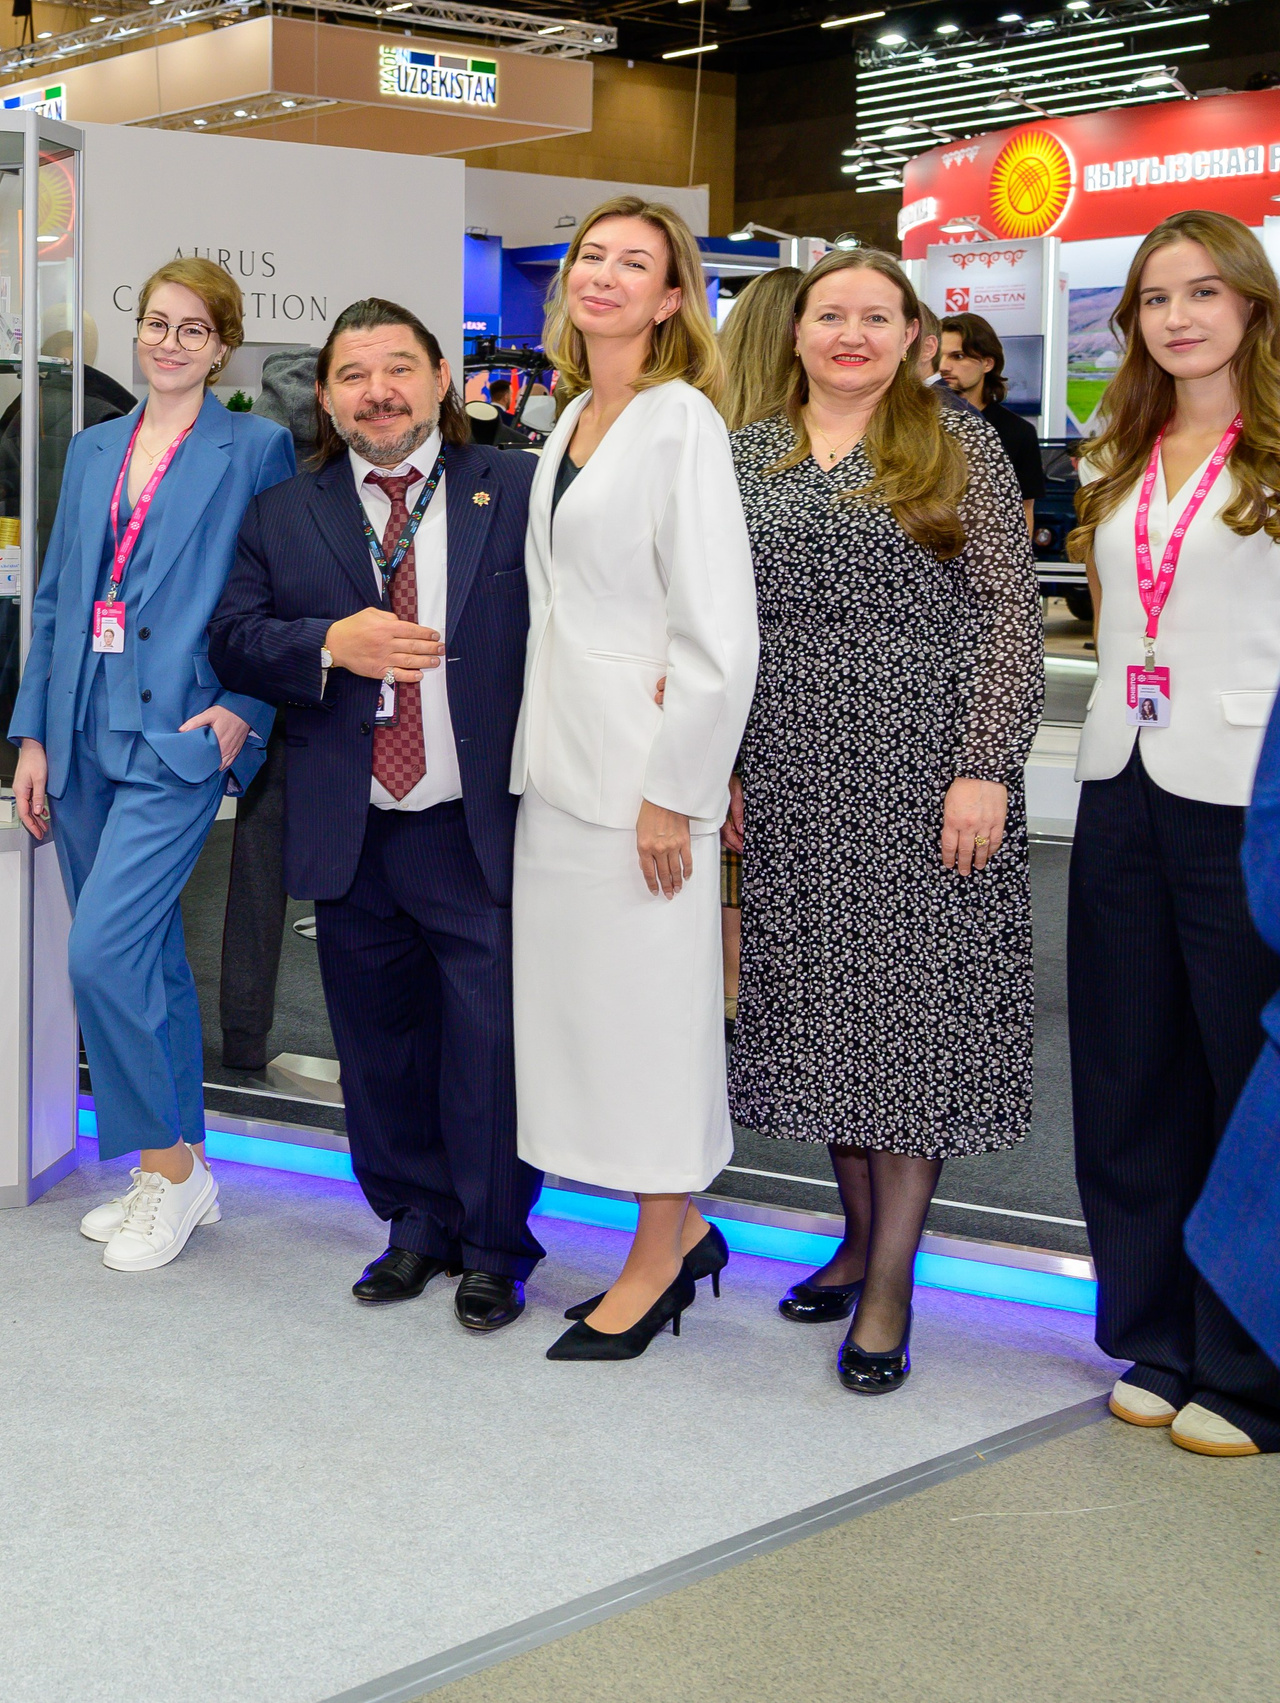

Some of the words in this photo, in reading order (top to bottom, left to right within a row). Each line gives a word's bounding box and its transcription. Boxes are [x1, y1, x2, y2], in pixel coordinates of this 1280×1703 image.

[380, 45, 396, 93] MADE
[397, 65, 497, 104] UZBEKISTAN
[1084, 145, 1265, 192] КЫРГЫЗСКАЯ
[113, 285, 327, 322] CTION
[974, 293, 1025, 304] DASTAN
